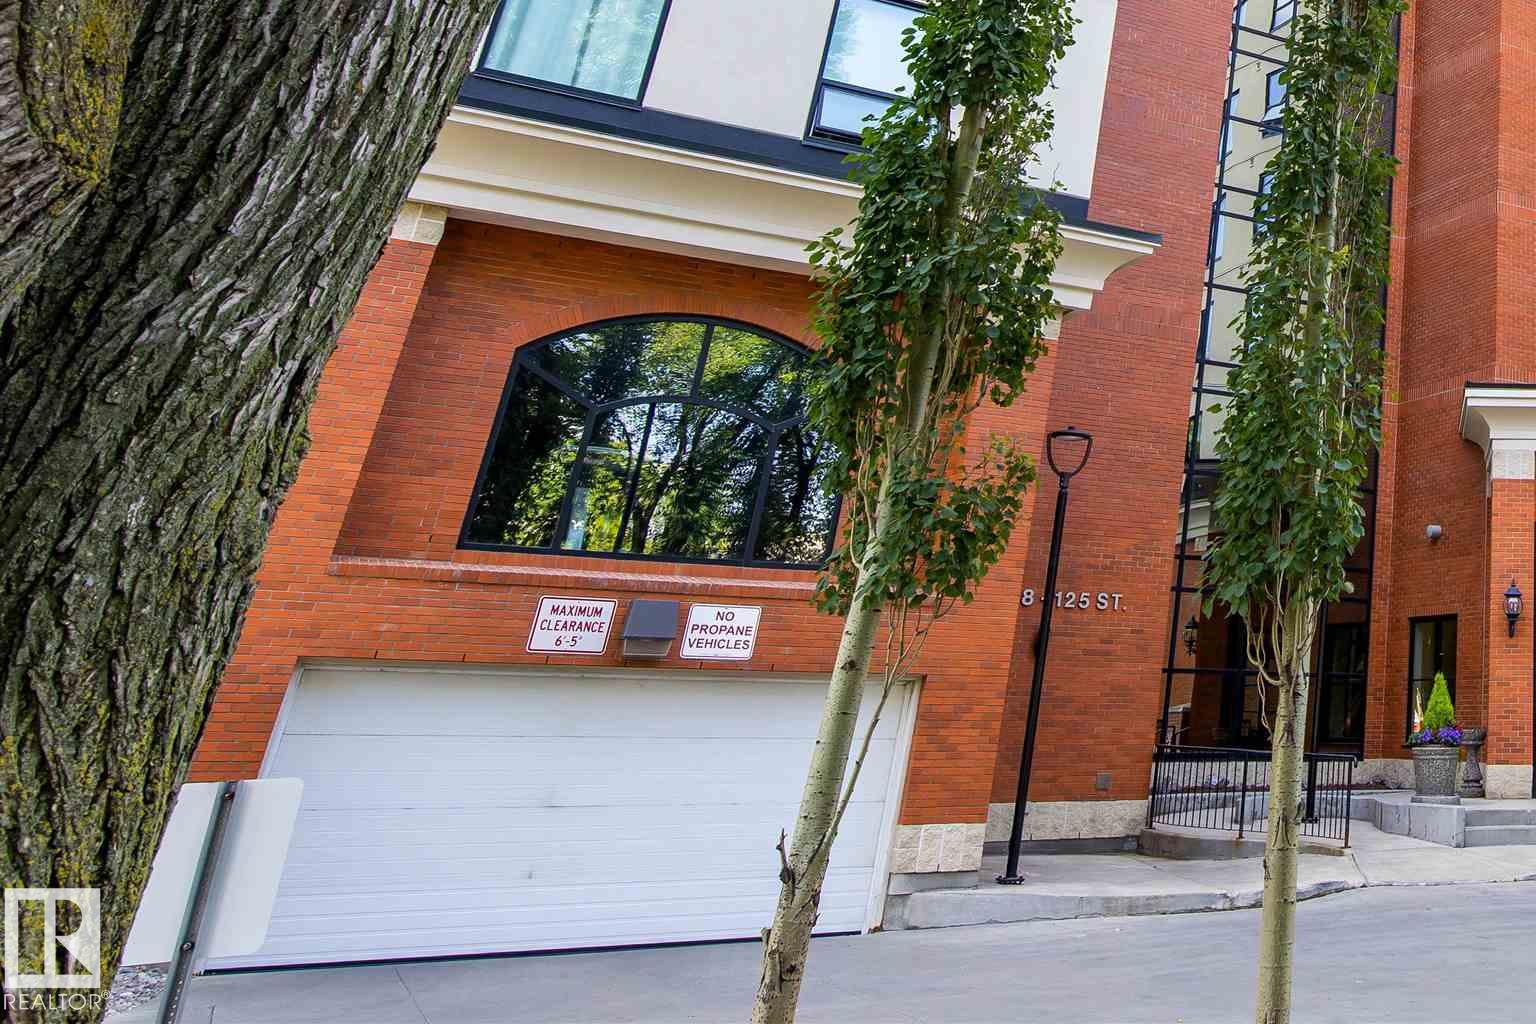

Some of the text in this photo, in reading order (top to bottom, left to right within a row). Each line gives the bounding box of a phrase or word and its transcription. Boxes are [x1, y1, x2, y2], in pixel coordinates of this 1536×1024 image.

[1055, 591, 1091, 609] 125
[1096, 592, 1128, 611] ST.
[550, 604, 604, 618] MAXIMUM
[715, 610, 736, 622] NO
[540, 619, 606, 633] CLEARANCE
[690, 623, 754, 637] PROPANE
[688, 638, 751, 650] VEHICLES
